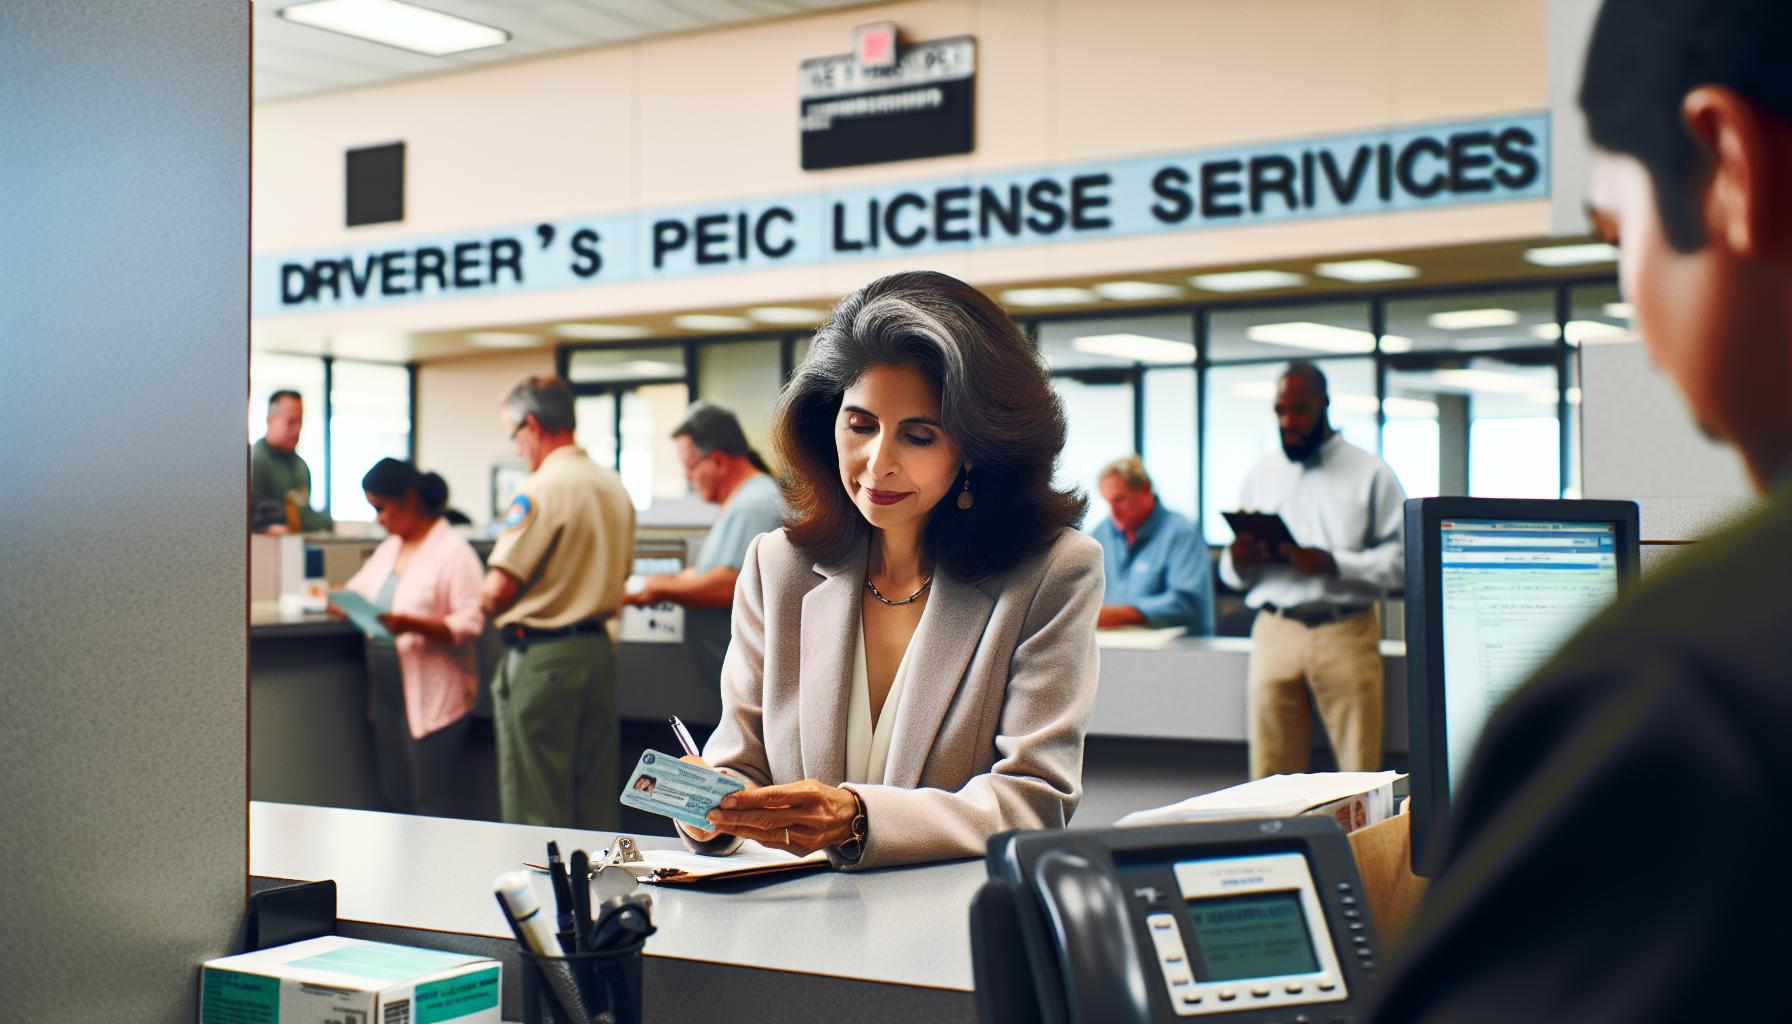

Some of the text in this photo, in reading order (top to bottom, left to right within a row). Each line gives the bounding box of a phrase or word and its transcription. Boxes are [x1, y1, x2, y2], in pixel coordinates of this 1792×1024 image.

[653, 206, 797, 270] PEIC
[832, 172, 1112, 254] LICENSE
[1150, 126, 1541, 225] SERIVICES
